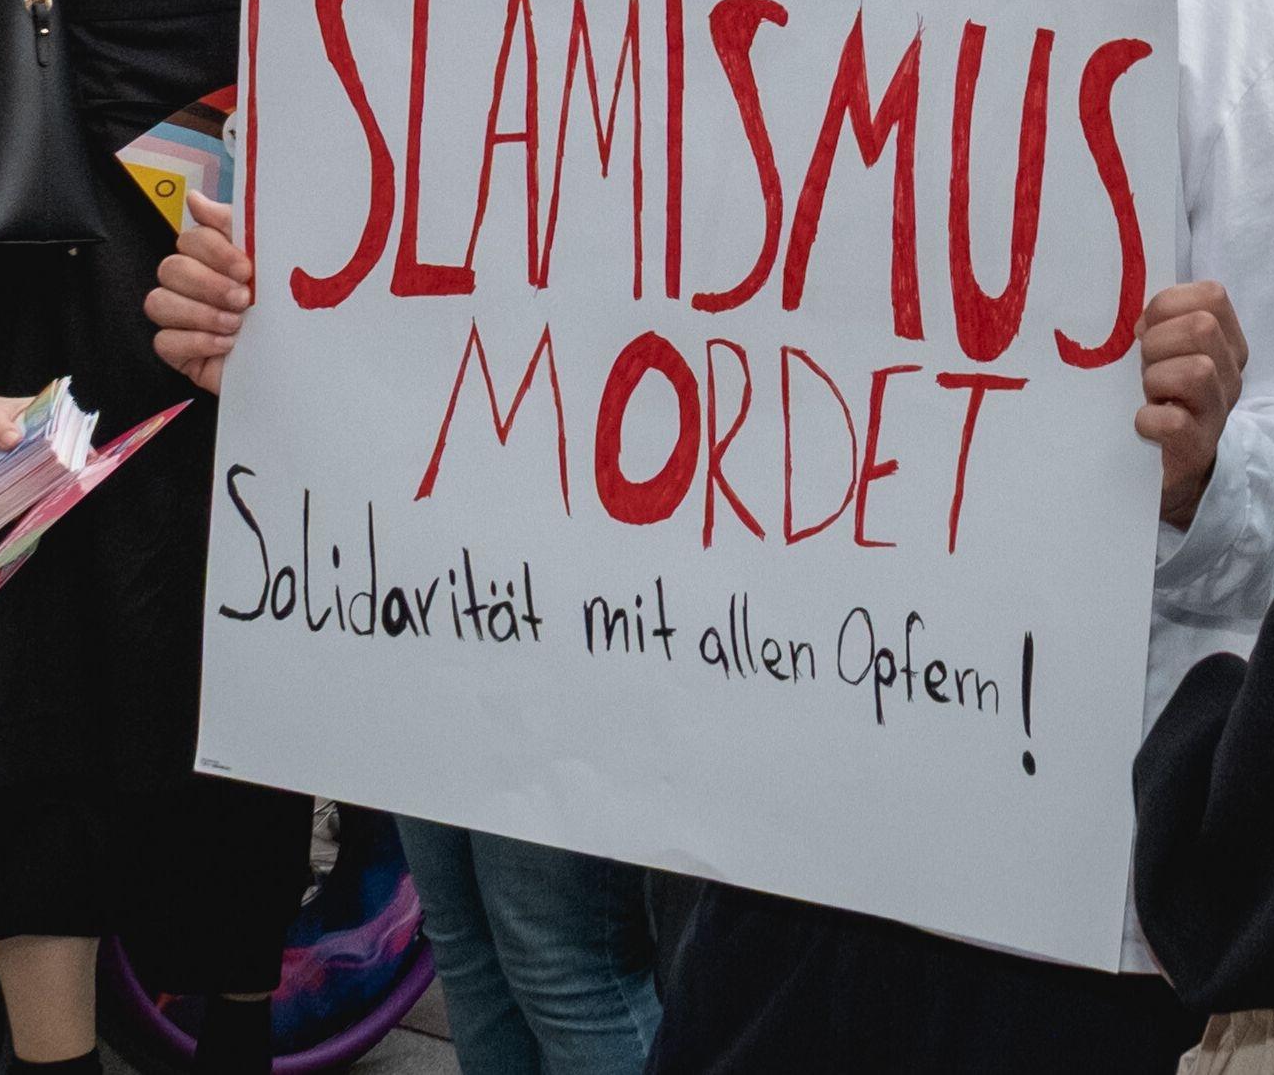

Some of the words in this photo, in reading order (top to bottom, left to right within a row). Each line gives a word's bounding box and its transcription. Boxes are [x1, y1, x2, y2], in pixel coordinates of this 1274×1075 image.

[414, 316, 1030, 555] MORDET
[219, 464, 543, 643] Solidarität
[583, 576, 677, 661] mit
[699, 592, 816, 684] allen
